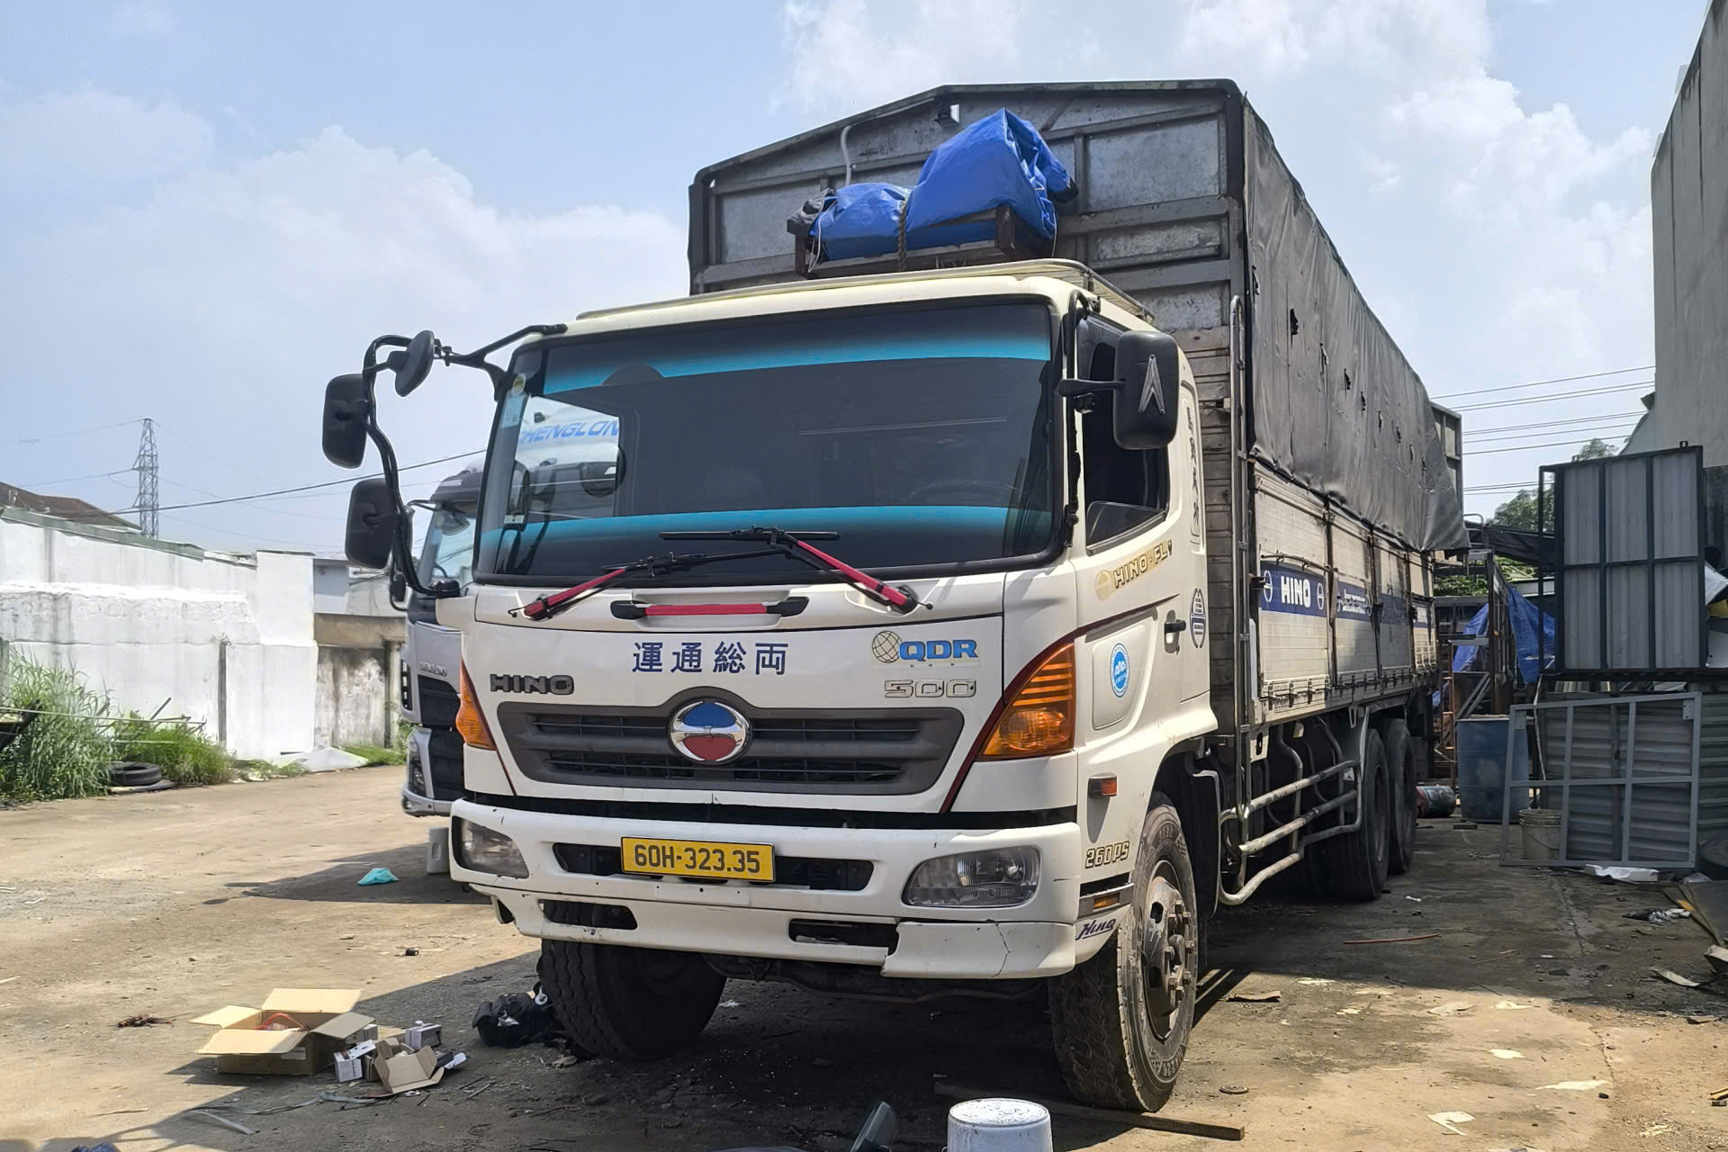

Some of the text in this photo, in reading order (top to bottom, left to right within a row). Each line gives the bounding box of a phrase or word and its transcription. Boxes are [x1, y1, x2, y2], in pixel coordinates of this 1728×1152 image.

[1281, 575, 1311, 608] HINO
[632, 641, 789, 675] 運通総両
[899, 639, 978, 662] QDR
[489, 673, 575, 696] HINO
[884, 680, 977, 698] 500
[634, 844, 760, 873] 60H-323.35
[1085, 841, 1130, 869] 260PS
